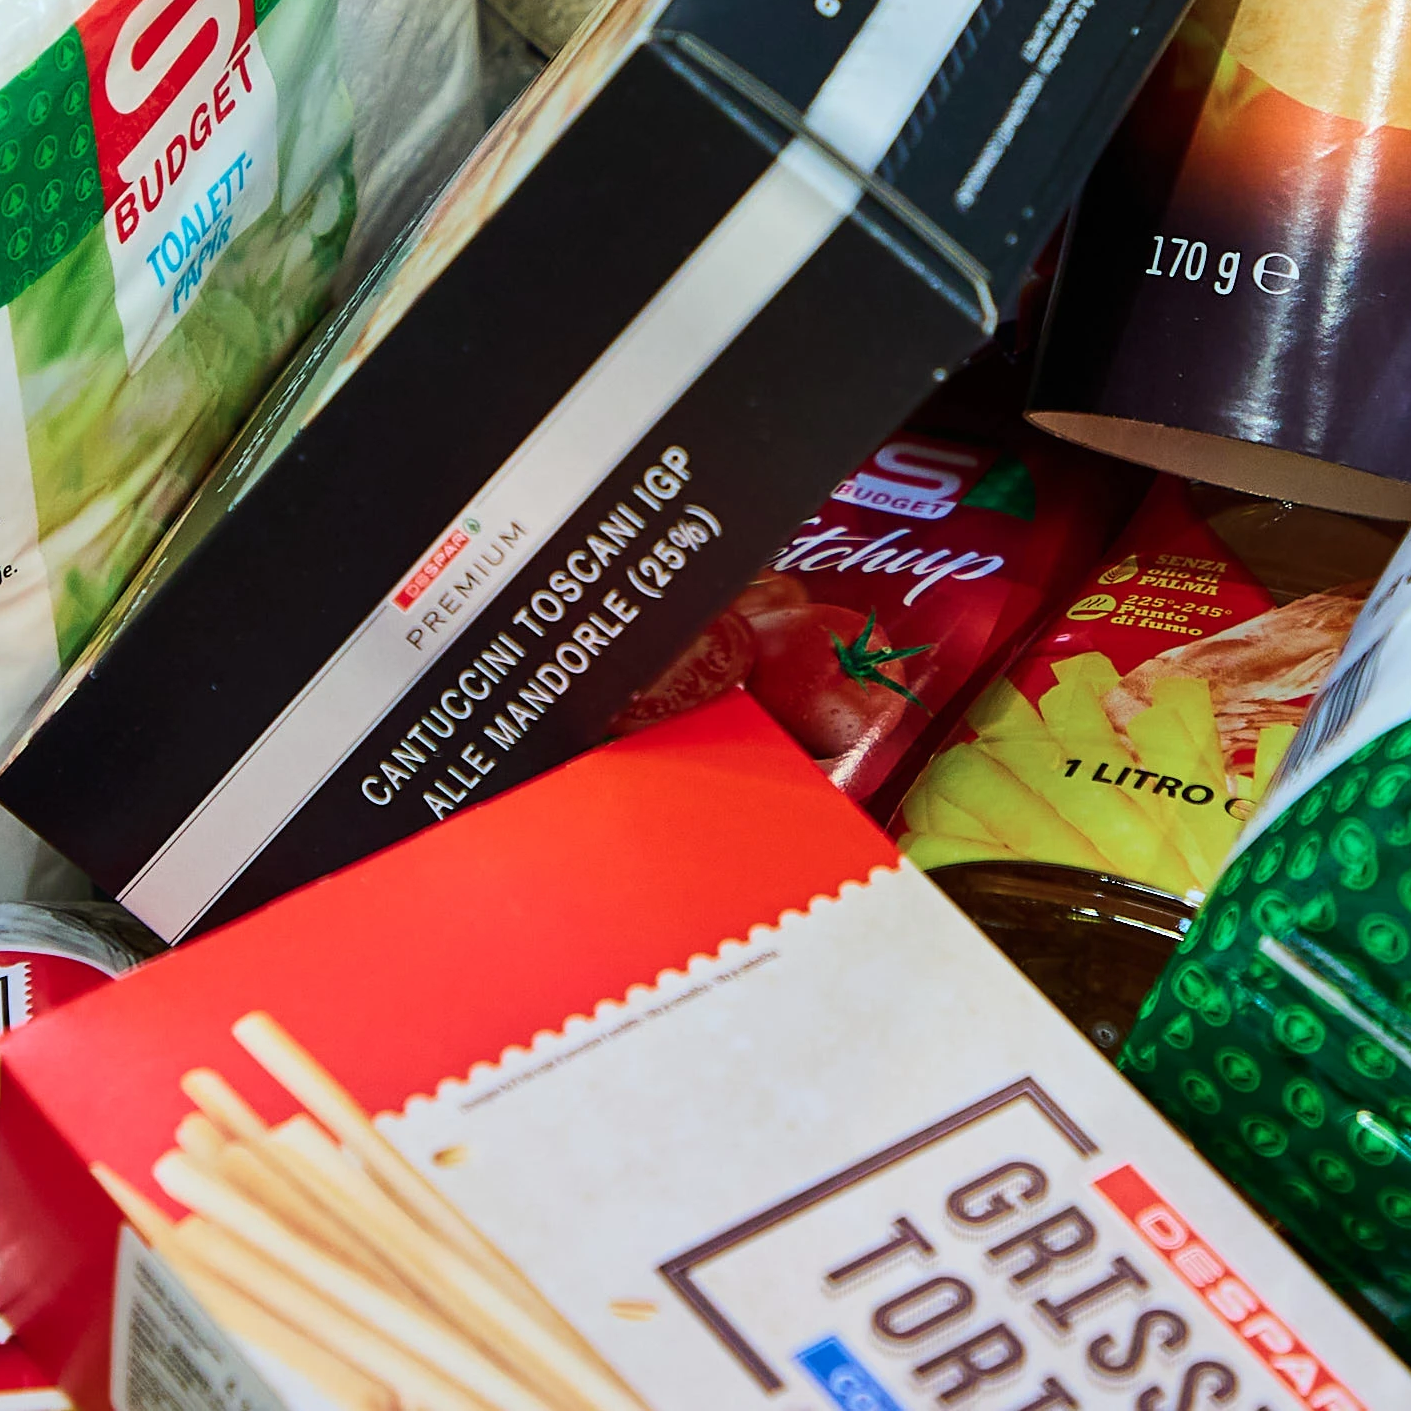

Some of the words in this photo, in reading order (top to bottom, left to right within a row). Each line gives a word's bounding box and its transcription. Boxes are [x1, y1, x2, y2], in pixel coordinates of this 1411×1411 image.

[114, 44, 254, 244] BUDGET
[146, 150, 253, 286] TOALETT-
[1144, 235, 1207, 283] 170
[1213, 249, 1241, 296] g
[835, 482, 945, 517] BUDGET
[404, 531, 469, 600] DESPAR
[405, 519, 529, 651] PREMIUM
[764, 525, 1004, 607] tchup
[1138, 575, 1219, 596] PALMA
[1147, 568, 1191, 580] olio
[1196, 572, 1221, 585] di
[1156, 553, 1227, 573] SENZA
[360, 632, 526, 808] CANTUCCINI
[512, 503, 646, 639] TOSCANI
[632, 444, 692, 515] IGP
[1110, 615, 1135, 625] di
[1138, 617, 1203, 636] fumo
[1116, 603, 1189, 623] Punto
[1123, 594, 1232, 618] 225°-245°
[422, 743, 497, 821] ALLE
[484, 589, 641, 754] MANDORLE
[627, 503, 723, 600] (25%)
[1063, 756, 1081, 779] 1
[1092, 763, 1214, 806] LITRO
[945, 1160, 1269, 1411] GRISS
